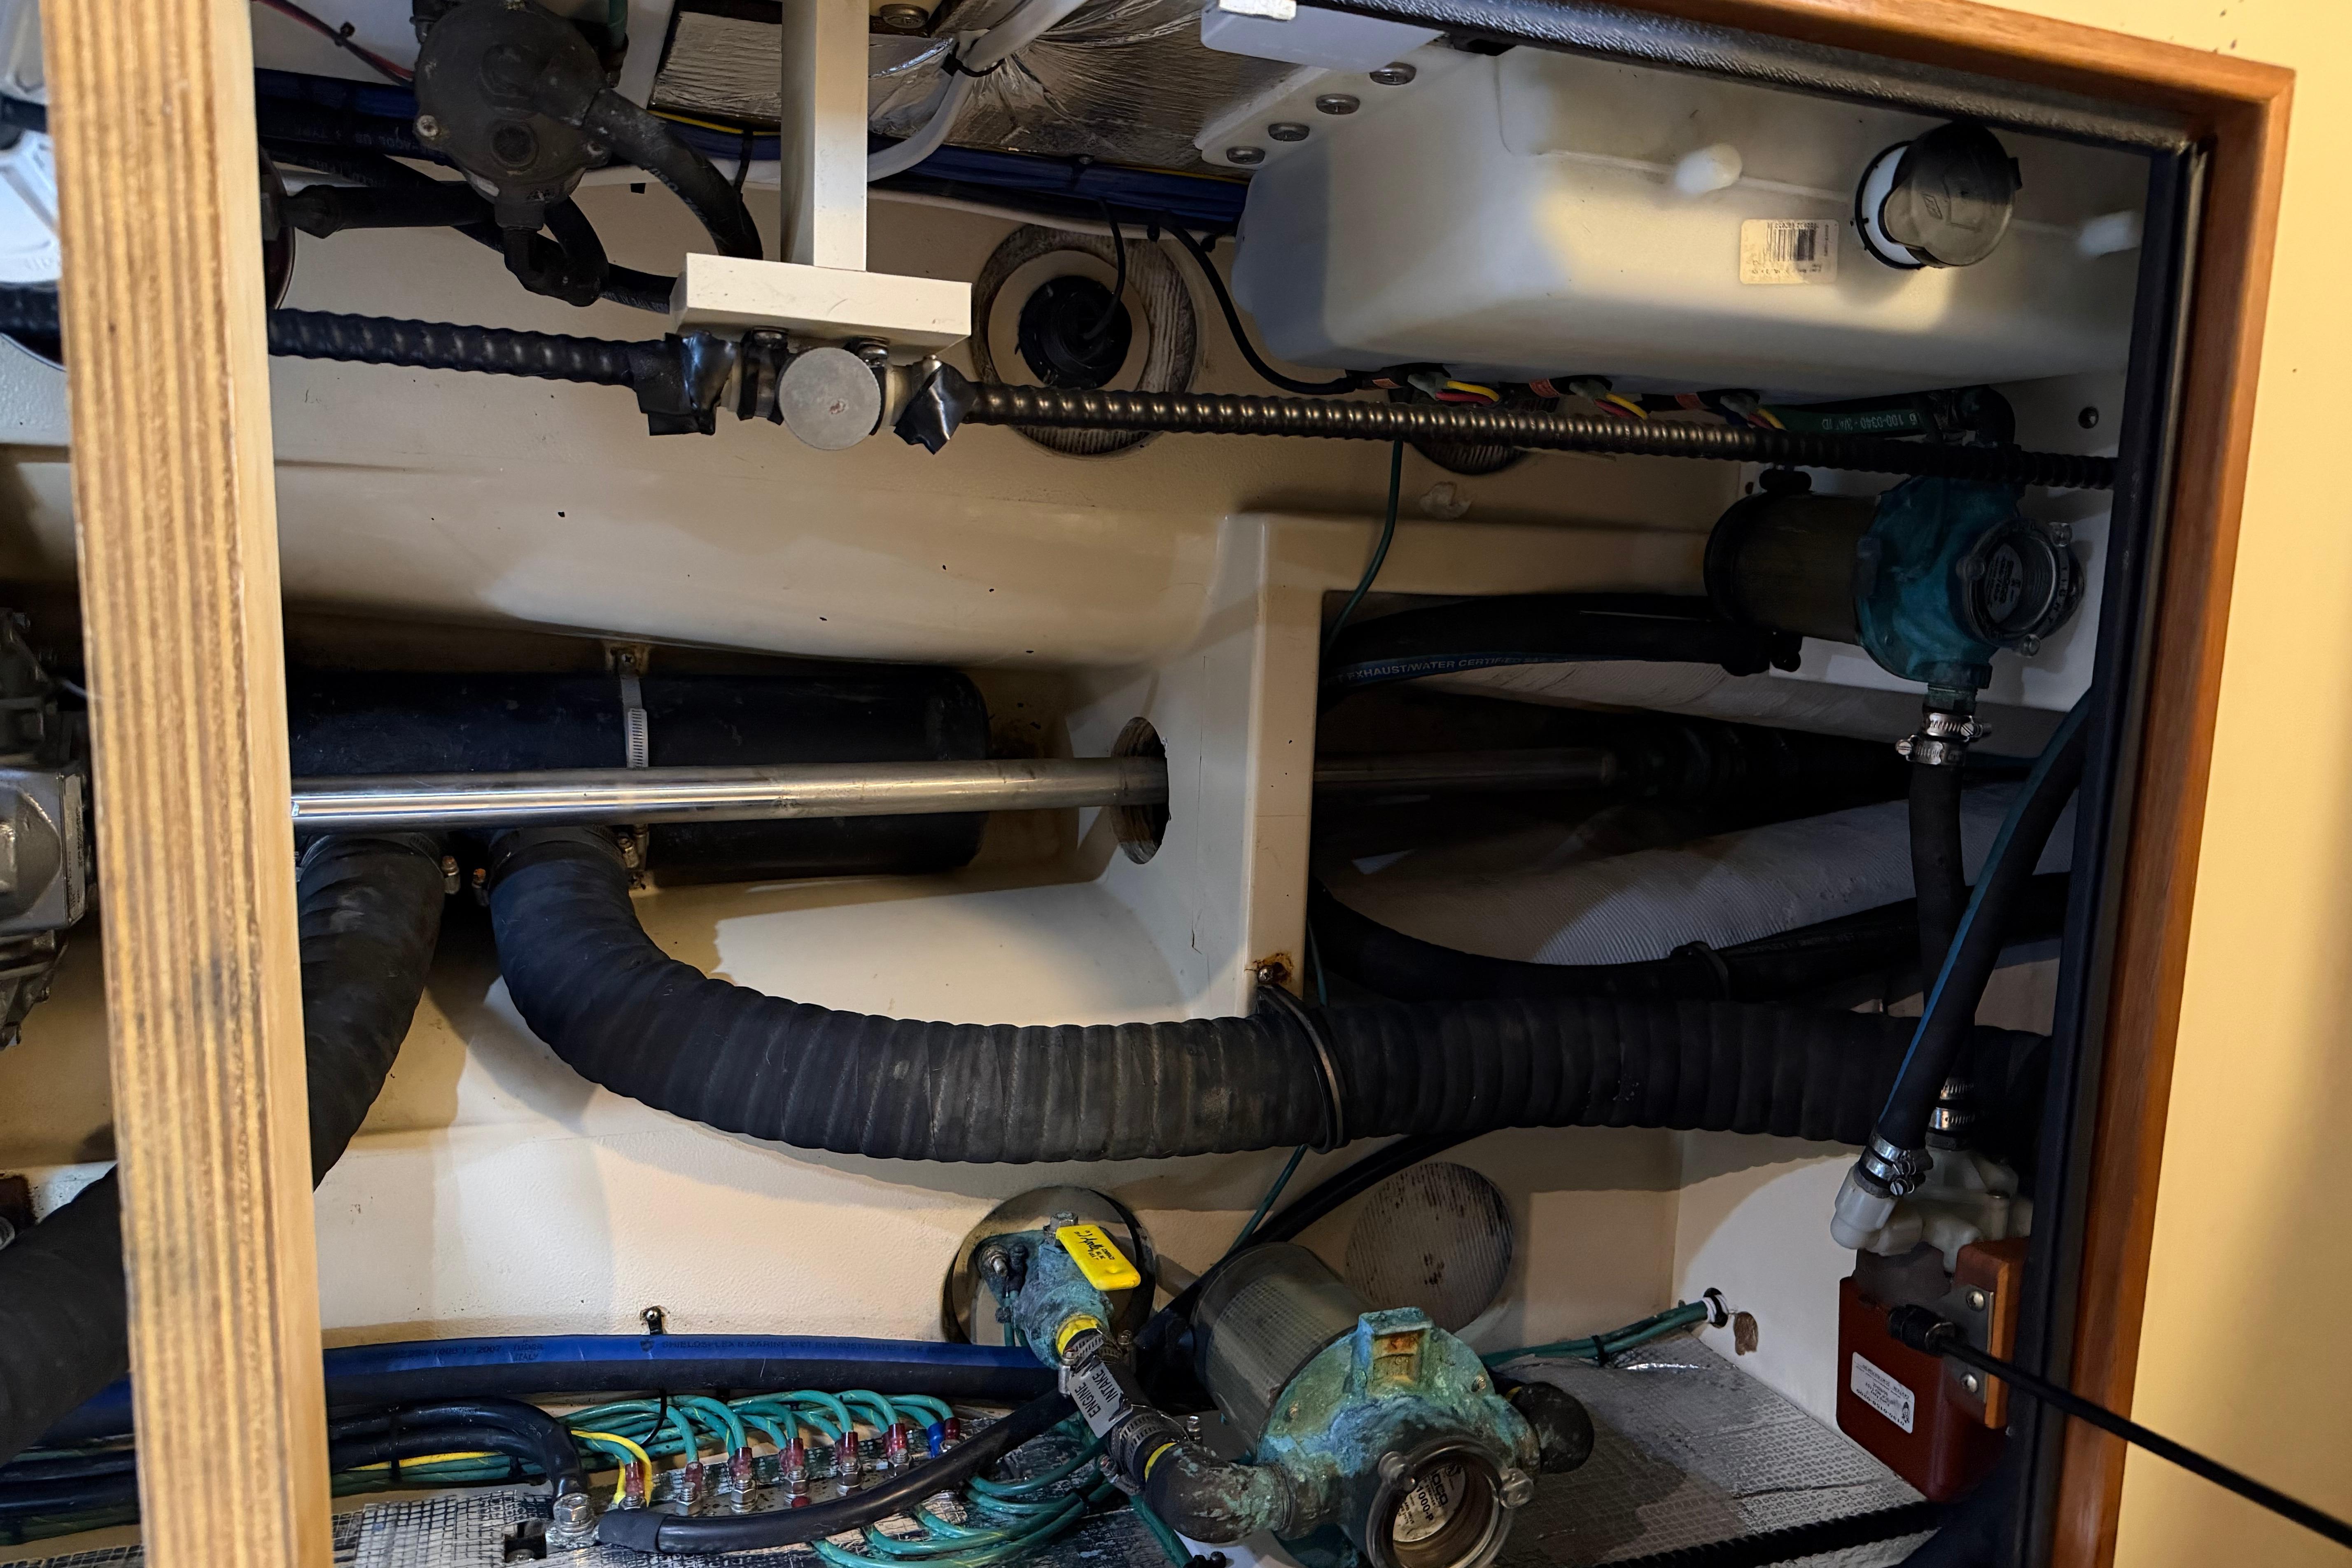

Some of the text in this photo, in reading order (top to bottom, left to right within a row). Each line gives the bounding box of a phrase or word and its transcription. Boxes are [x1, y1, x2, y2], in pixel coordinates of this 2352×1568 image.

[1345, 660, 1456, 681] EXHAUST/WATER
[1075, 1382, 1101, 1418] ENGINE
[1092, 1369, 1118, 1402] INTAKE
